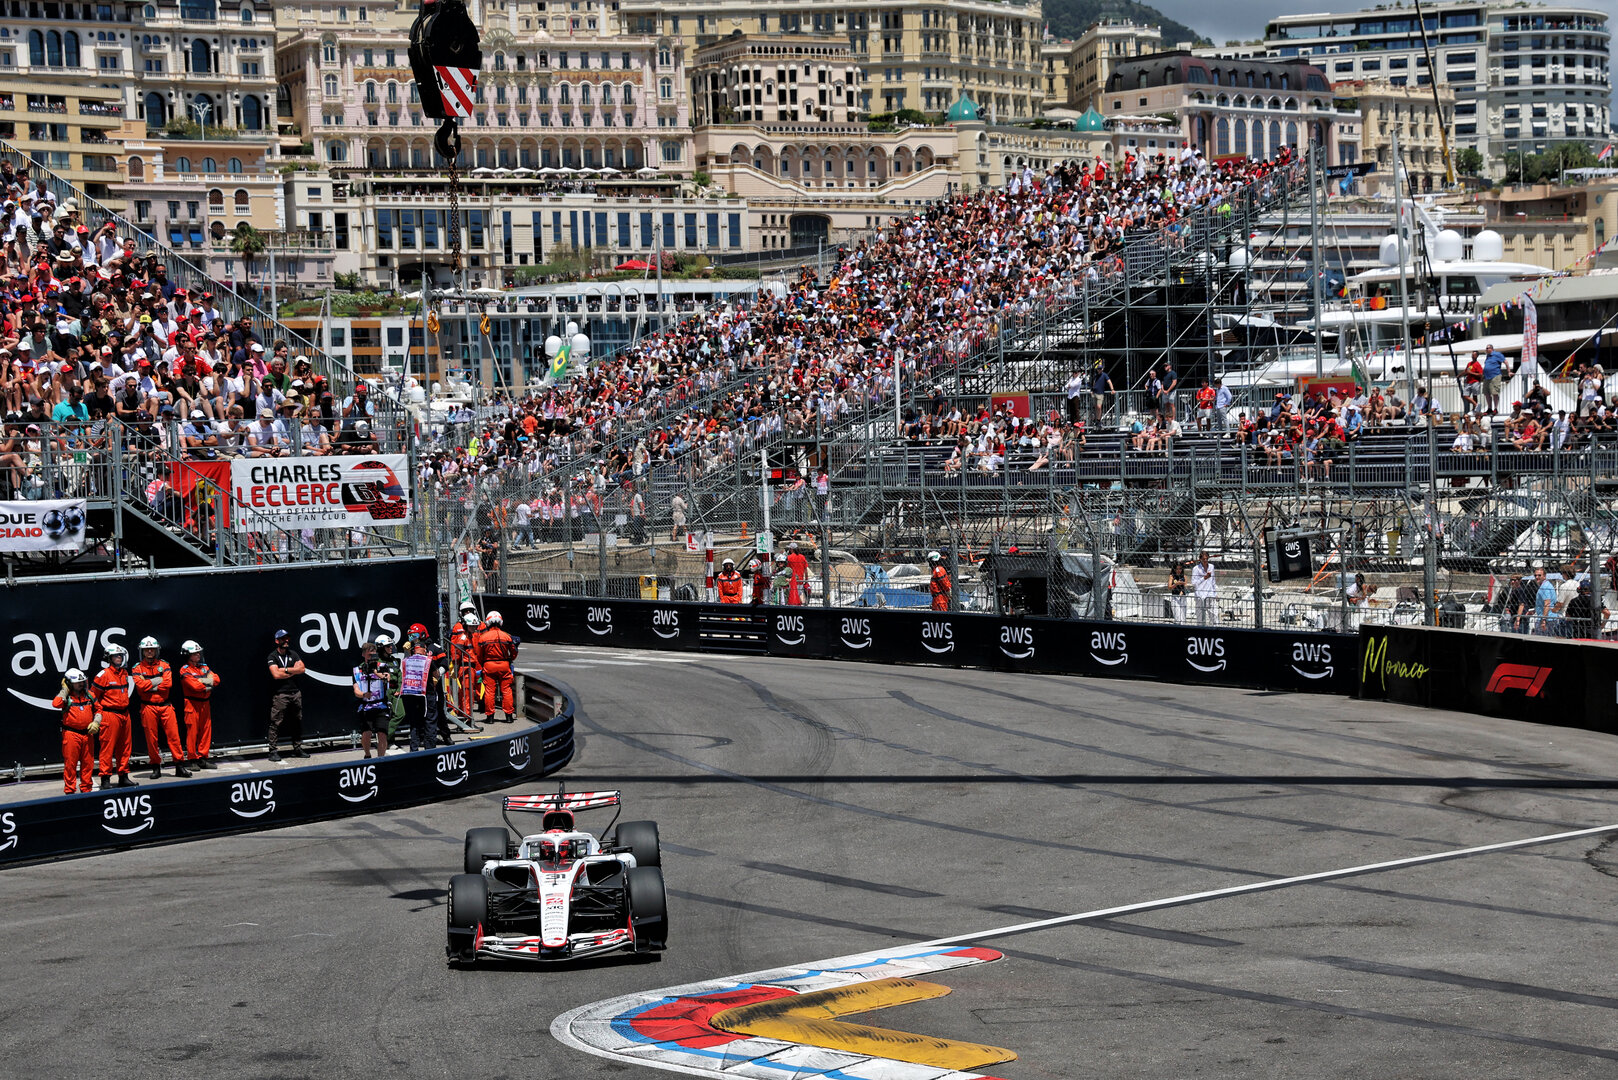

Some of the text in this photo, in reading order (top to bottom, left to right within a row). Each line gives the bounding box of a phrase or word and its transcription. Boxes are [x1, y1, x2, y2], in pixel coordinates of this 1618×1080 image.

[250, 463, 342, 485] CHARLES
[236, 482, 340, 508] LECLERC
[0, 513, 37, 525] DUE
[247, 512, 348, 524] MARCHE FAN CLUB
[286, 507, 334, 516] OFFICIAL
[1285, 541, 1300, 552] aws
[526, 603, 550, 619] aws
[587, 606, 612, 623] aws
[652, 609, 679, 626] aws
[299, 607, 402, 654] aws
[776, 614, 805, 632] aws
[841, 617, 871, 636] aws
[922, 621, 953, 640] aws
[1000, 625, 1033, 645] aws
[1091, 631, 1127, 651] aws
[11, 627, 129, 676] aws
[1187, 636, 1225, 657] aws
[1292, 641, 1332, 663] aws
[1362, 635, 1430, 690] Monaco
[1485, 662, 1553, 697] F1
[509, 736, 530, 758] aws
[436, 751, 467, 773] aws
[339, 765, 377, 789] aws
[230, 779, 274, 803] aws
[103, 794, 152, 819] aws
